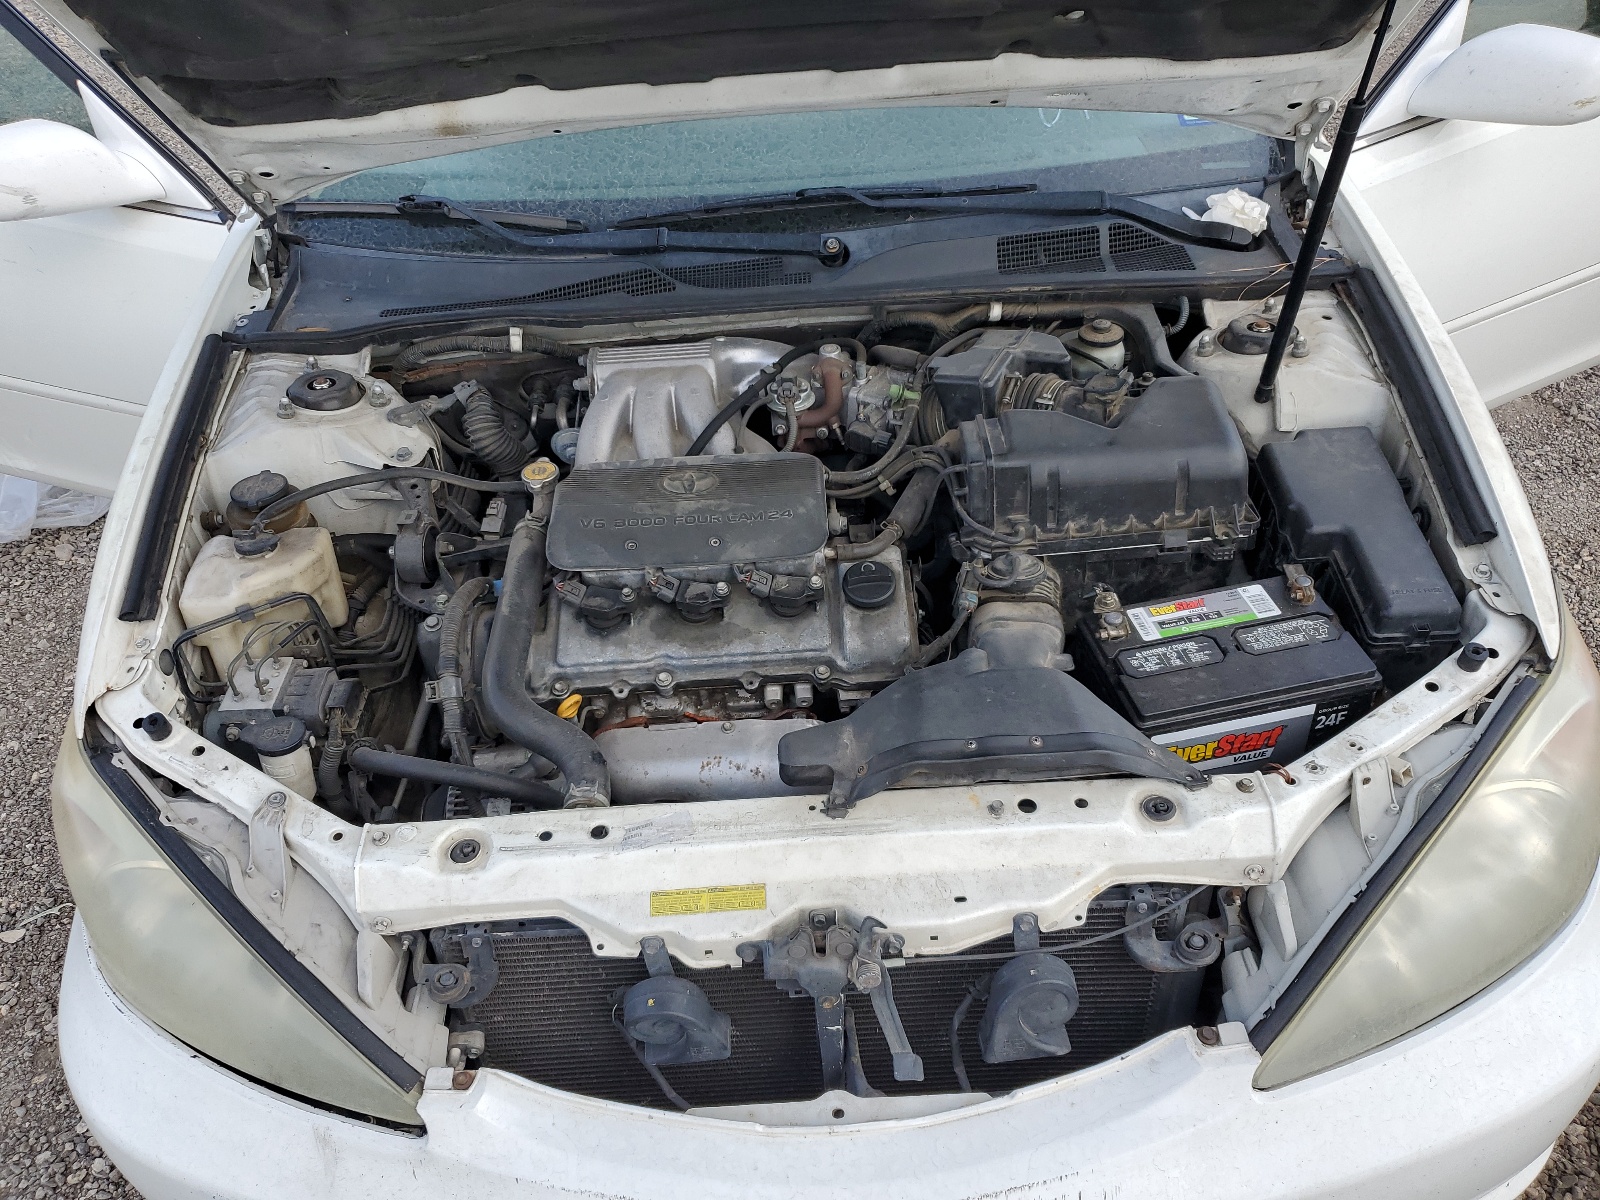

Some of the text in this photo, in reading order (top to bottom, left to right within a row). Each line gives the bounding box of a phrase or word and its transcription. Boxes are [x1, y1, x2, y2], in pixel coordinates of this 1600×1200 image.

[580, 508, 794, 530] V6 3000 FOUR CAM 24
[1149, 597, 1205, 617] EverStart
[1314, 710, 1348, 730] 24F
[1166, 724, 1284, 762] verStart
[1233, 749, 1268, 763] VALUE
